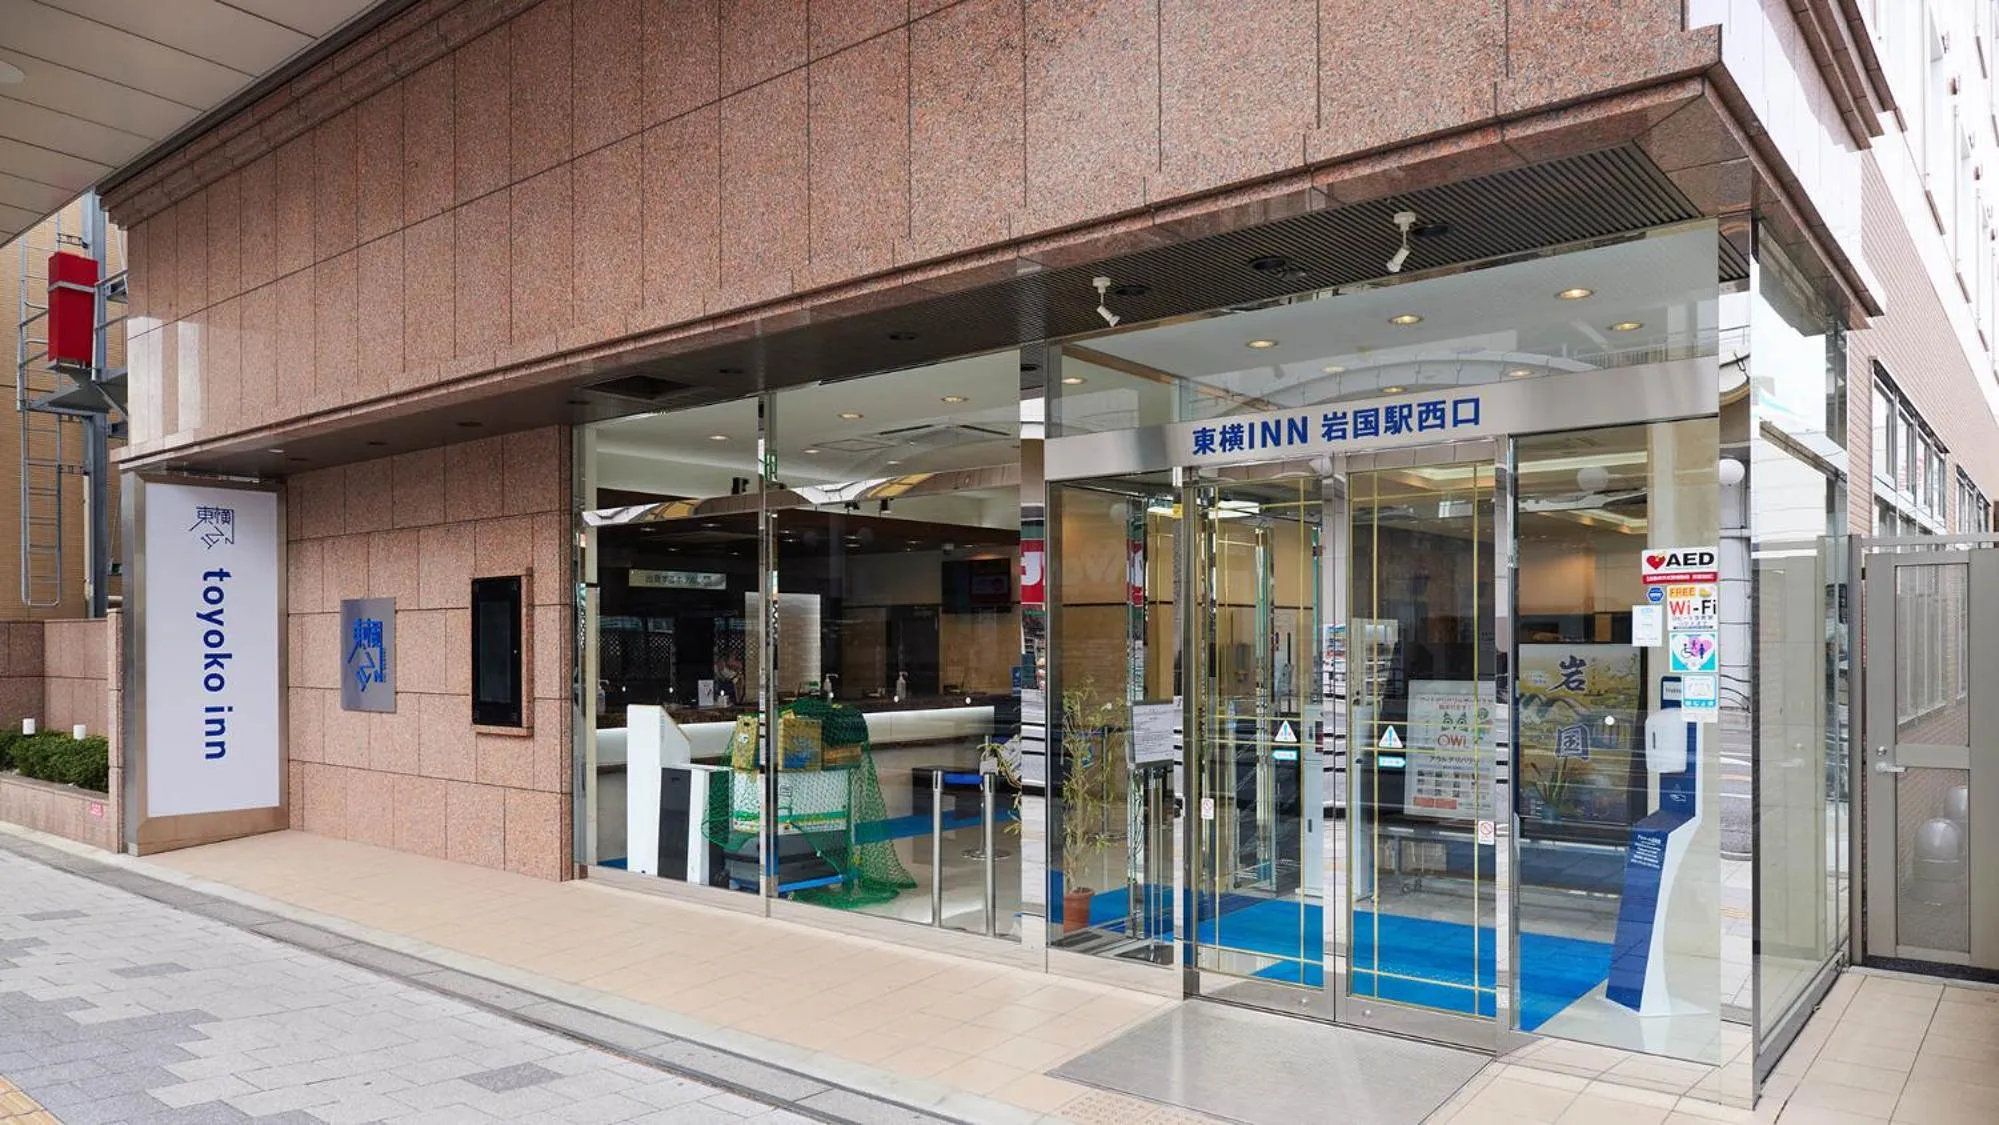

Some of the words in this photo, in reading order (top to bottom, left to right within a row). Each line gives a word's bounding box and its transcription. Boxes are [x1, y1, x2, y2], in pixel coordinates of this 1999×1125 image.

[1192, 416, 1309, 456] 東横INN
[1321, 397, 1481, 442] 岩国駅西口
[1665, 552, 1715, 567] AED
[1669, 587, 1697, 599] FREE
[1669, 599, 1717, 615] Wi-Fi
[196, 567, 233, 693] toyoko
[204, 706, 234, 760] inn
